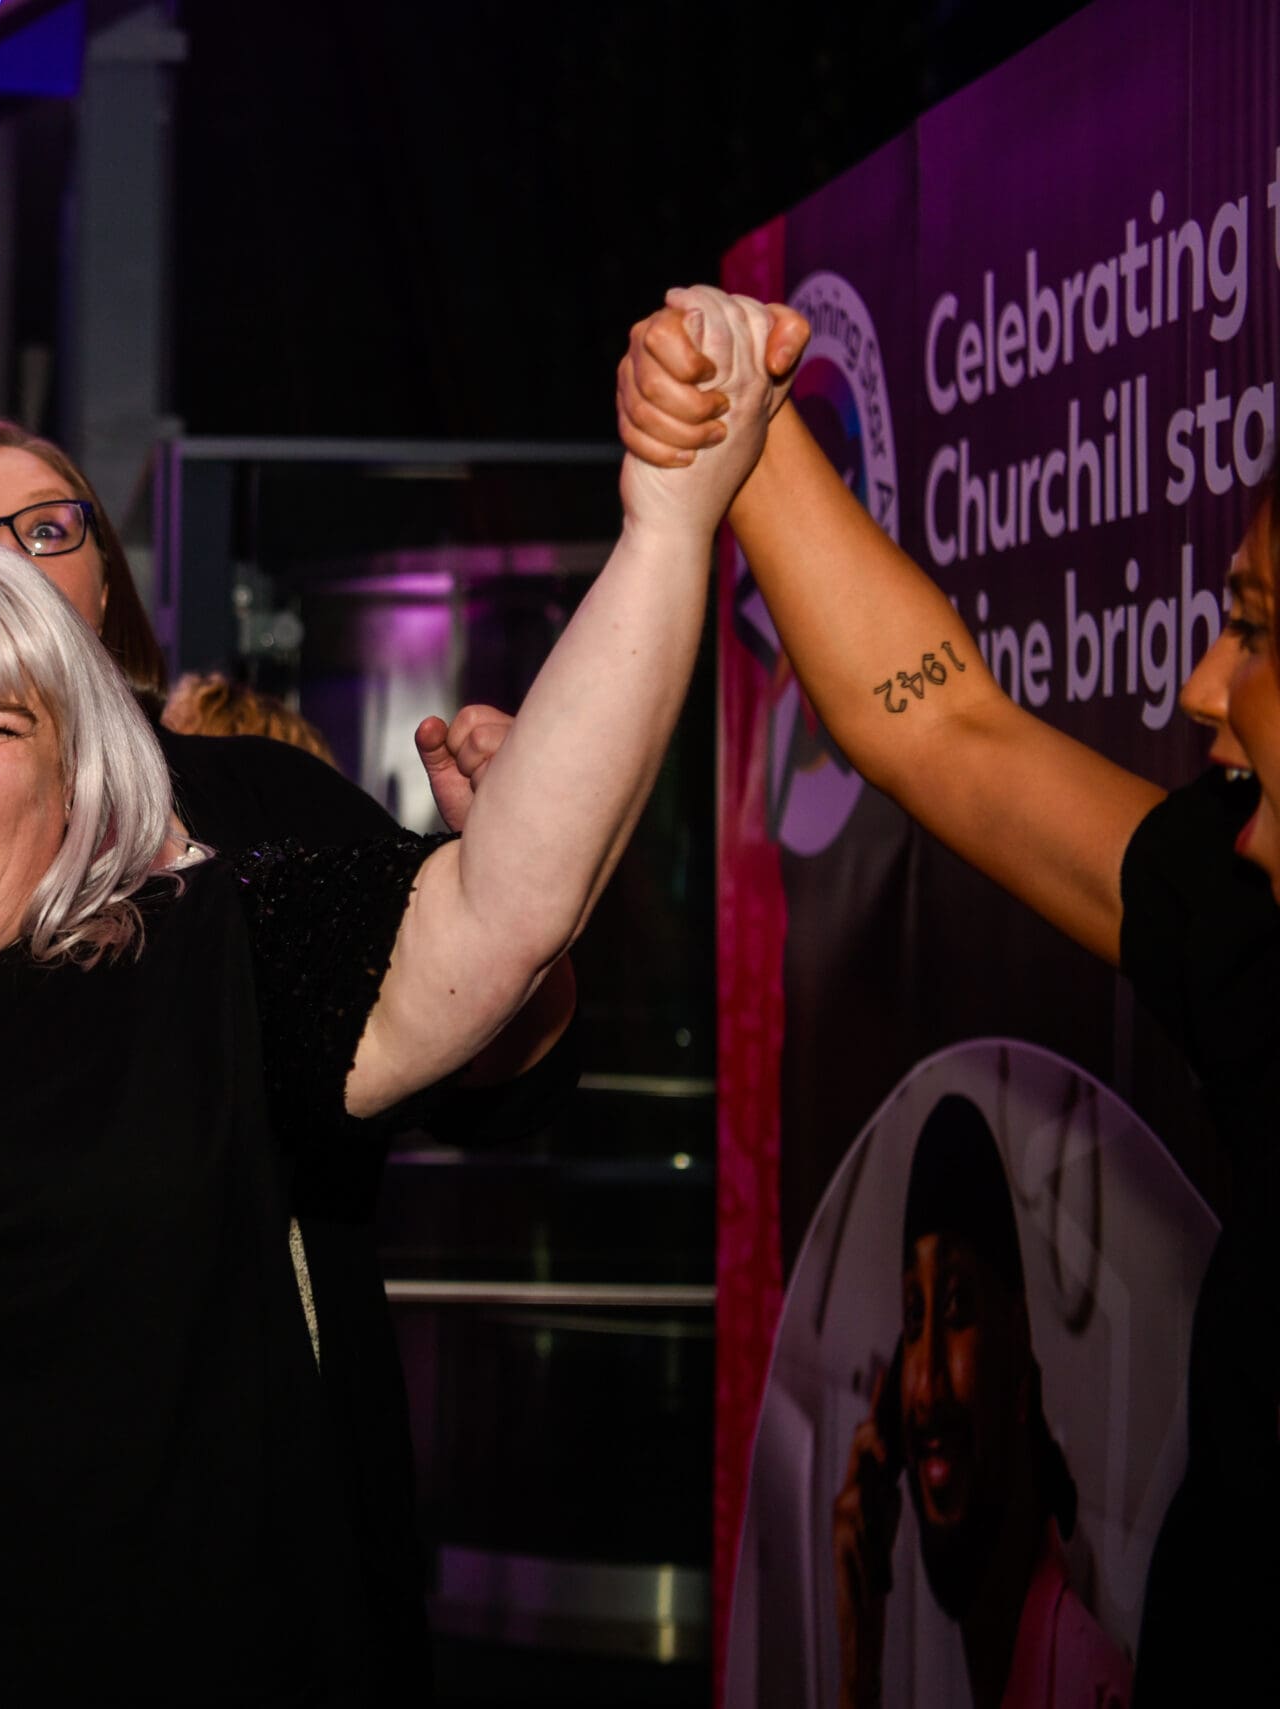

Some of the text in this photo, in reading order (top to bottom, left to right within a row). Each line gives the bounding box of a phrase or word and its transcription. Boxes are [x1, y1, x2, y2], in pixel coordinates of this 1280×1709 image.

[924, 188, 1249, 415] Celebrating
[924, 368, 1277, 567] Churchill sta
[873, 640, 966, 714] 1942
[1064, 543, 1233, 731] brigh
